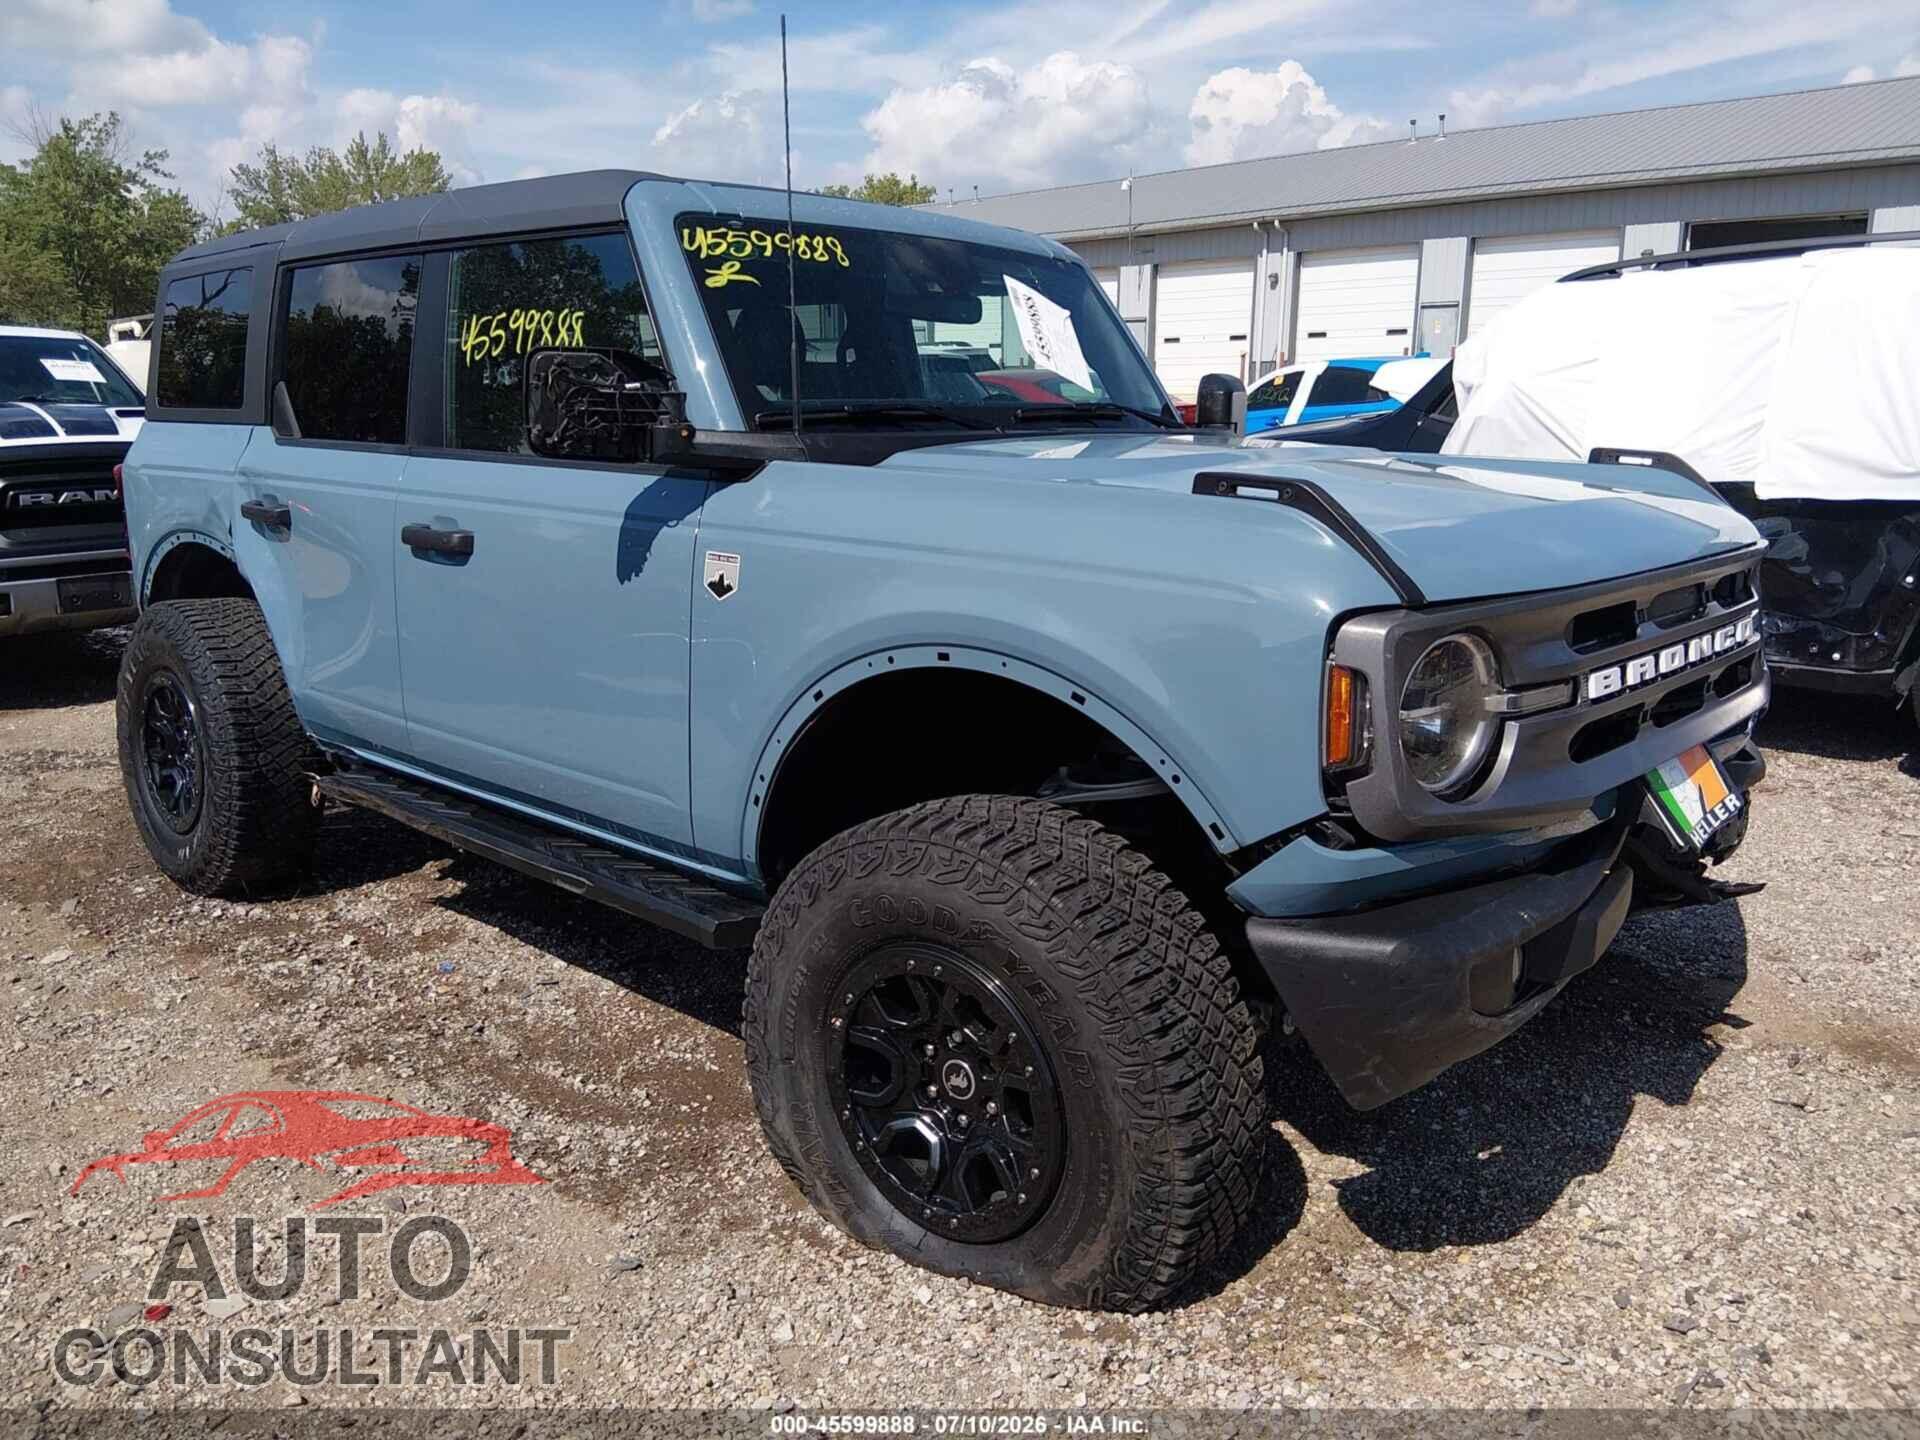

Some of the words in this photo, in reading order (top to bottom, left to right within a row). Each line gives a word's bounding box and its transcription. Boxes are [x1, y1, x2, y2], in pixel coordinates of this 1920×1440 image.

[682, 227, 849, 267] 45599888
[461, 308, 584, 368] 45599888
[19, 488, 118, 506] RAM
[1588, 613, 1760, 700] BRONCO
[1689, 793, 1741, 848] HELLER
